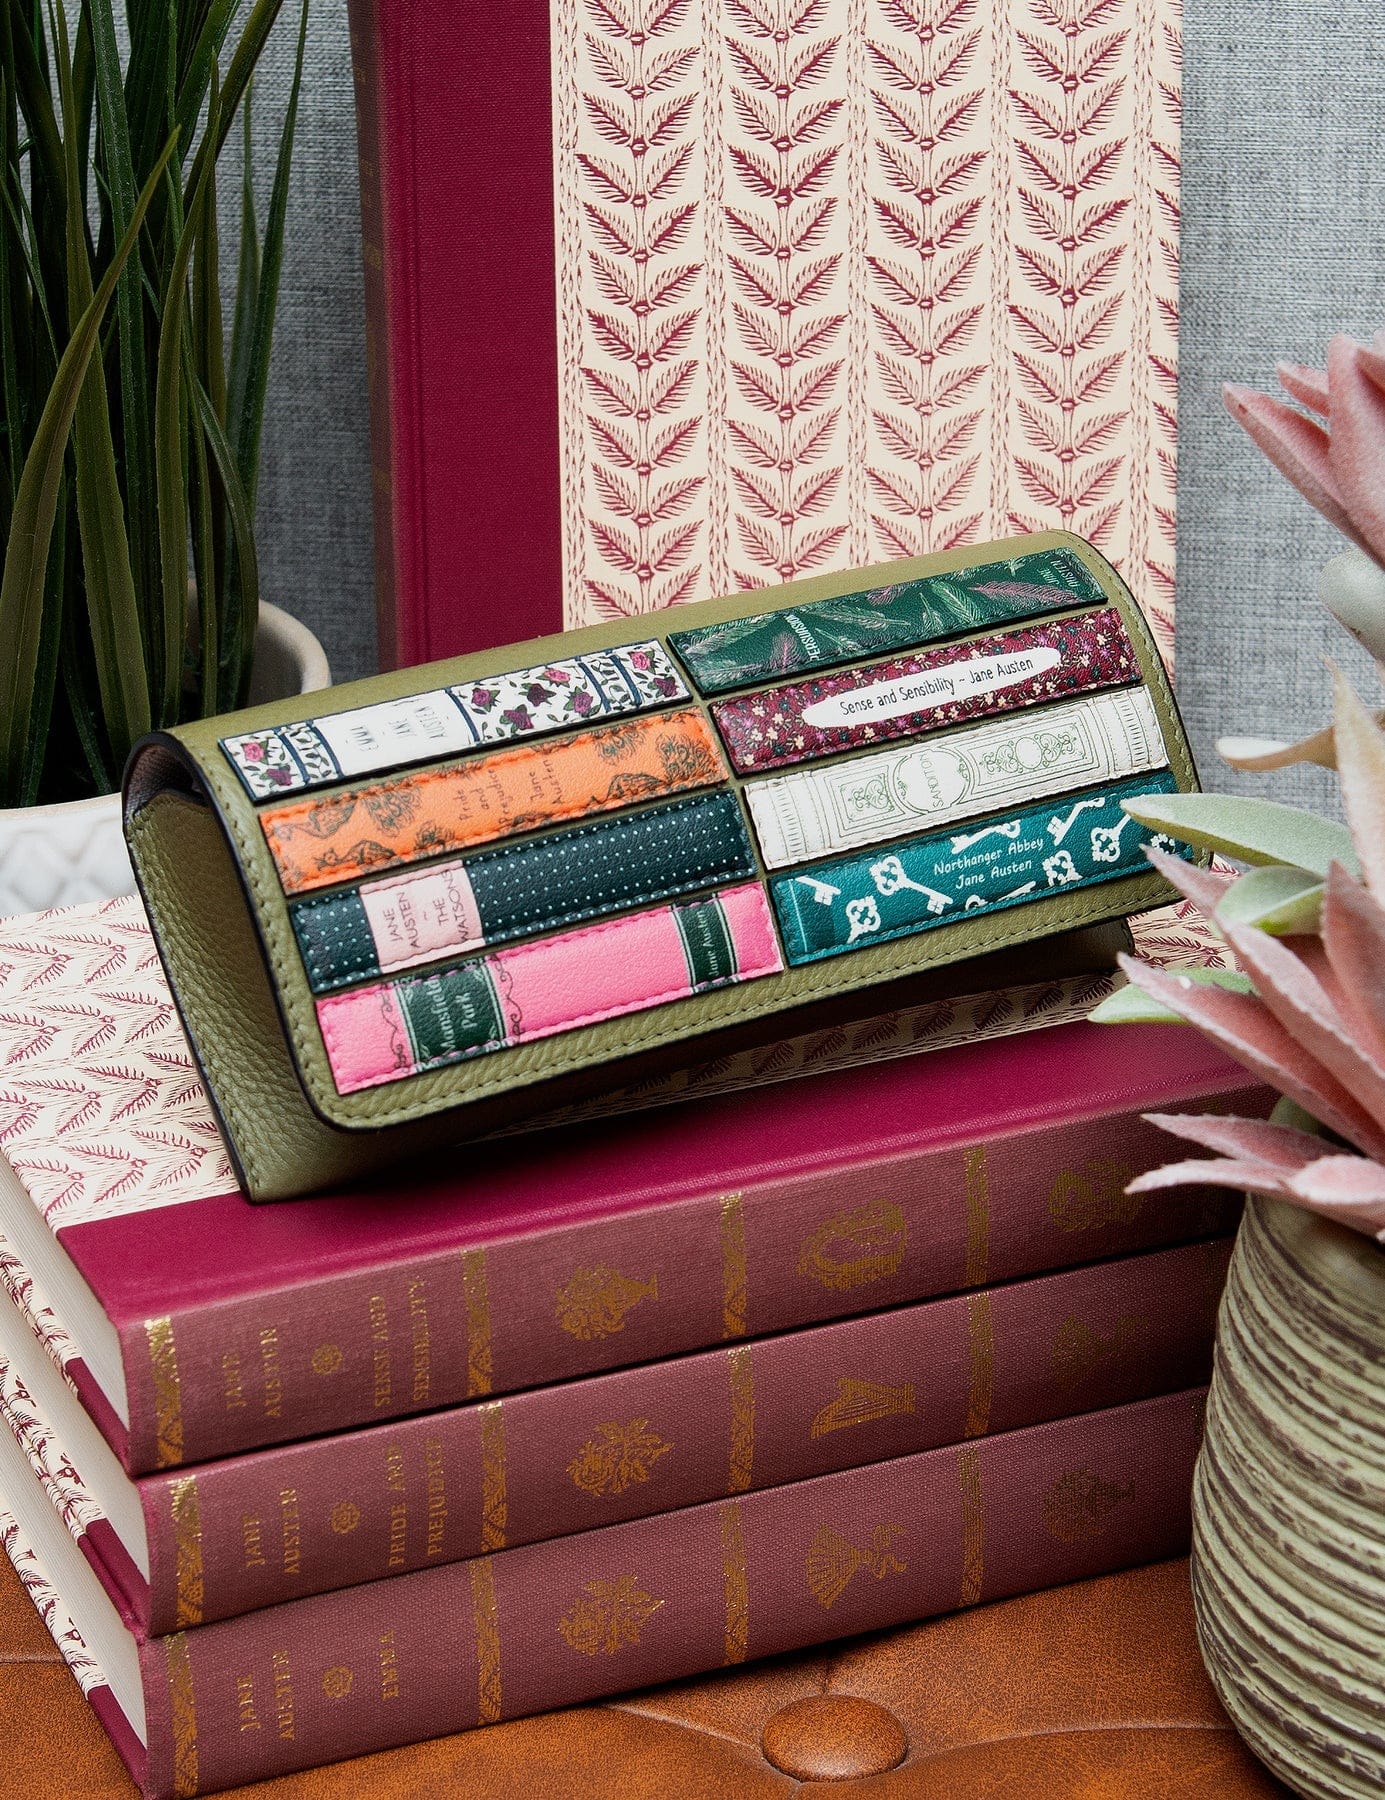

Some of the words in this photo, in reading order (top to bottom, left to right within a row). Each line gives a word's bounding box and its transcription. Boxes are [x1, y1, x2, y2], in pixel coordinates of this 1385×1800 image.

[1050, 560, 1080, 587] AUSTEN
[784, 614, 820, 661] PERSUASION
[839, 700, 874, 717] Sense
[878, 690, 897, 706] and
[899, 677, 955, 702] Sensibility
[969, 669, 994, 684] Jane
[997, 658, 1034, 676] Austen
[453, 790, 473, 820] Pride
[471, 788, 489, 810] and
[486, 769, 513, 824] Prejudice
[530, 771, 544, 801] Jane
[543, 759, 564, 804] Austen
[920, 754, 944, 808] SANDITON
[934, 849, 1003, 875] Northanger
[1008, 838, 1044, 855] Abbey
[955, 873, 986, 889] Jane
[991, 859, 1032, 879] Austen
[383, 908, 403, 941] JANE
[396, 892, 420, 948] AUSTEN
[433, 898, 449, 926] THE
[441, 870, 469, 941] WATSONS
[696, 910, 715, 947] Austen
[708, 950, 720, 976] Jane
[423, 980, 456, 1055] Mansfield
[455, 992, 478, 1029] Park
[369, 1295, 388, 1341] AND
[408, 1277, 431, 1401] SENSIBILITY
[222, 1353, 247, 1410] JANE
[259, 1328, 282, 1417] AUSTEN
[373, 1348, 392, 1408] SENSE
[386, 1445, 405, 1491] AND
[425, 1437, 449, 1556] PREJUDICE
[243, 1512, 265, 1568] JANE
[279, 1488, 300, 1574] AUSTEN
[388, 1502, 407, 1568] PRIDE
[379, 1630, 399, 1700] EMMA
[236, 1673, 261, 1731] JANE
[272, 1651, 294, 1741] AUSTEN
